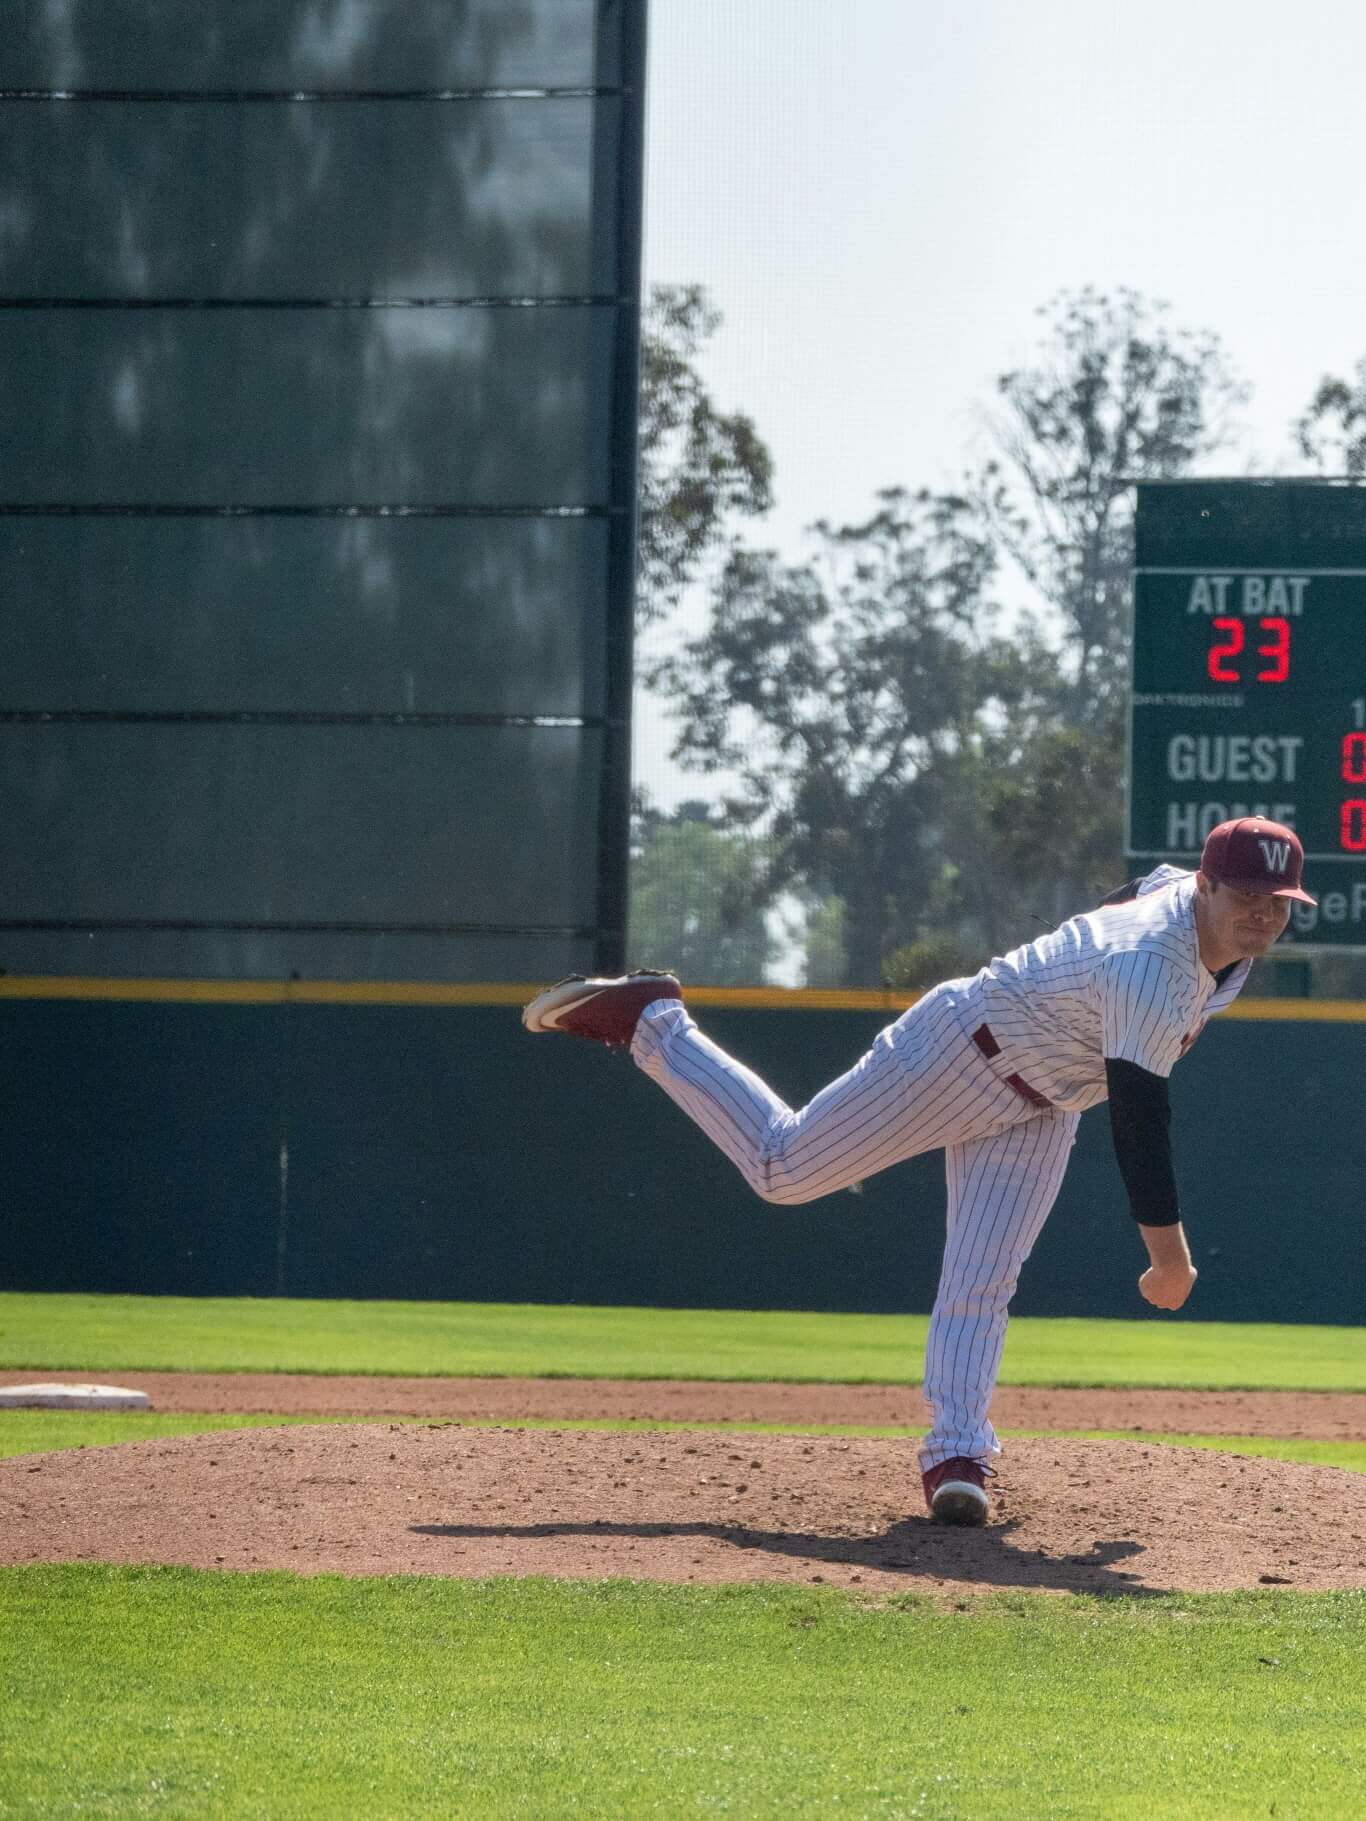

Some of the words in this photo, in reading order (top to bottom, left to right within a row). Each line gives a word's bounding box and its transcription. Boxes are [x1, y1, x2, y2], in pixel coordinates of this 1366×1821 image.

[1188, 577, 1233, 614] AT
[1243, 578, 1310, 616] BAT
[1208, 618, 1290, 682] 23
[1352, 699, 1366, 728] 1
[1168, 735, 1303, 782] GUEST
[1258, 839, 1291, 874] W
